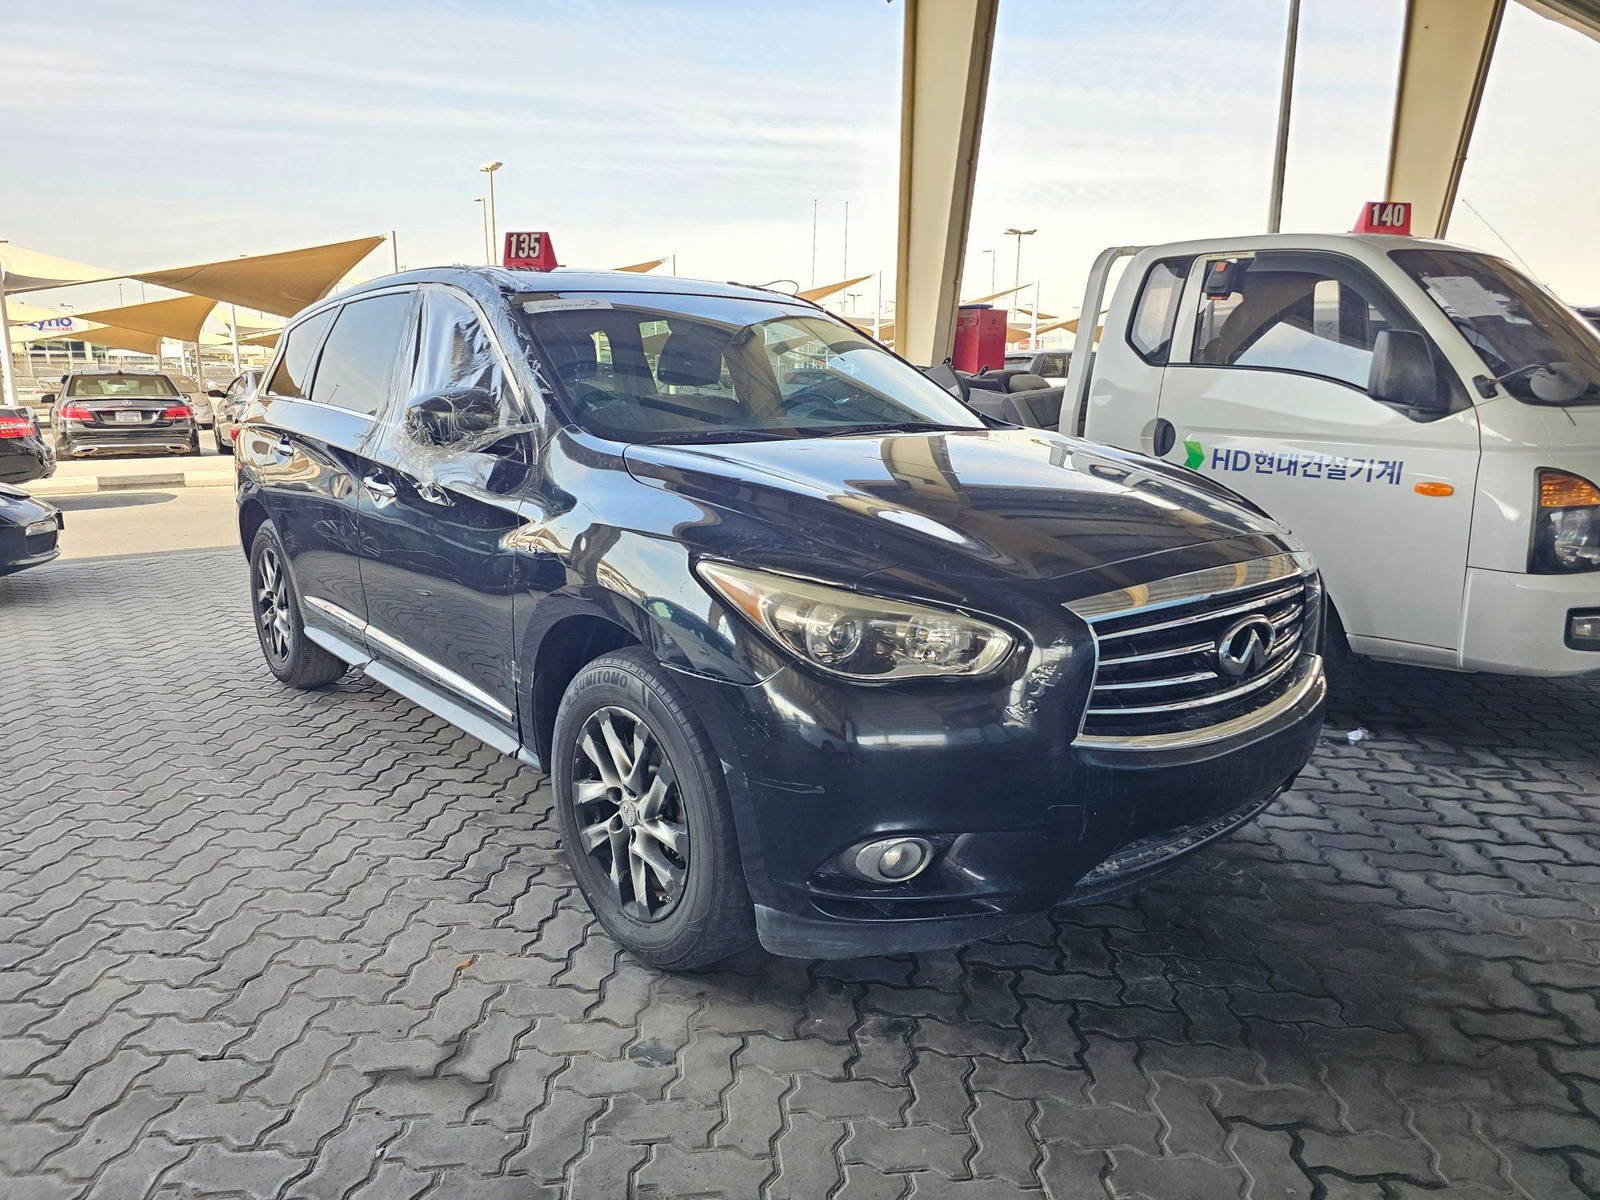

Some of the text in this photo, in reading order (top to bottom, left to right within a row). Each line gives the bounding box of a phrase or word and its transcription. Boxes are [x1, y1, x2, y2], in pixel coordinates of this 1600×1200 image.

[1372, 204, 1405, 227] 140
[510, 233, 540, 258] 135
[573, 670, 628, 695] SUMITOMO
